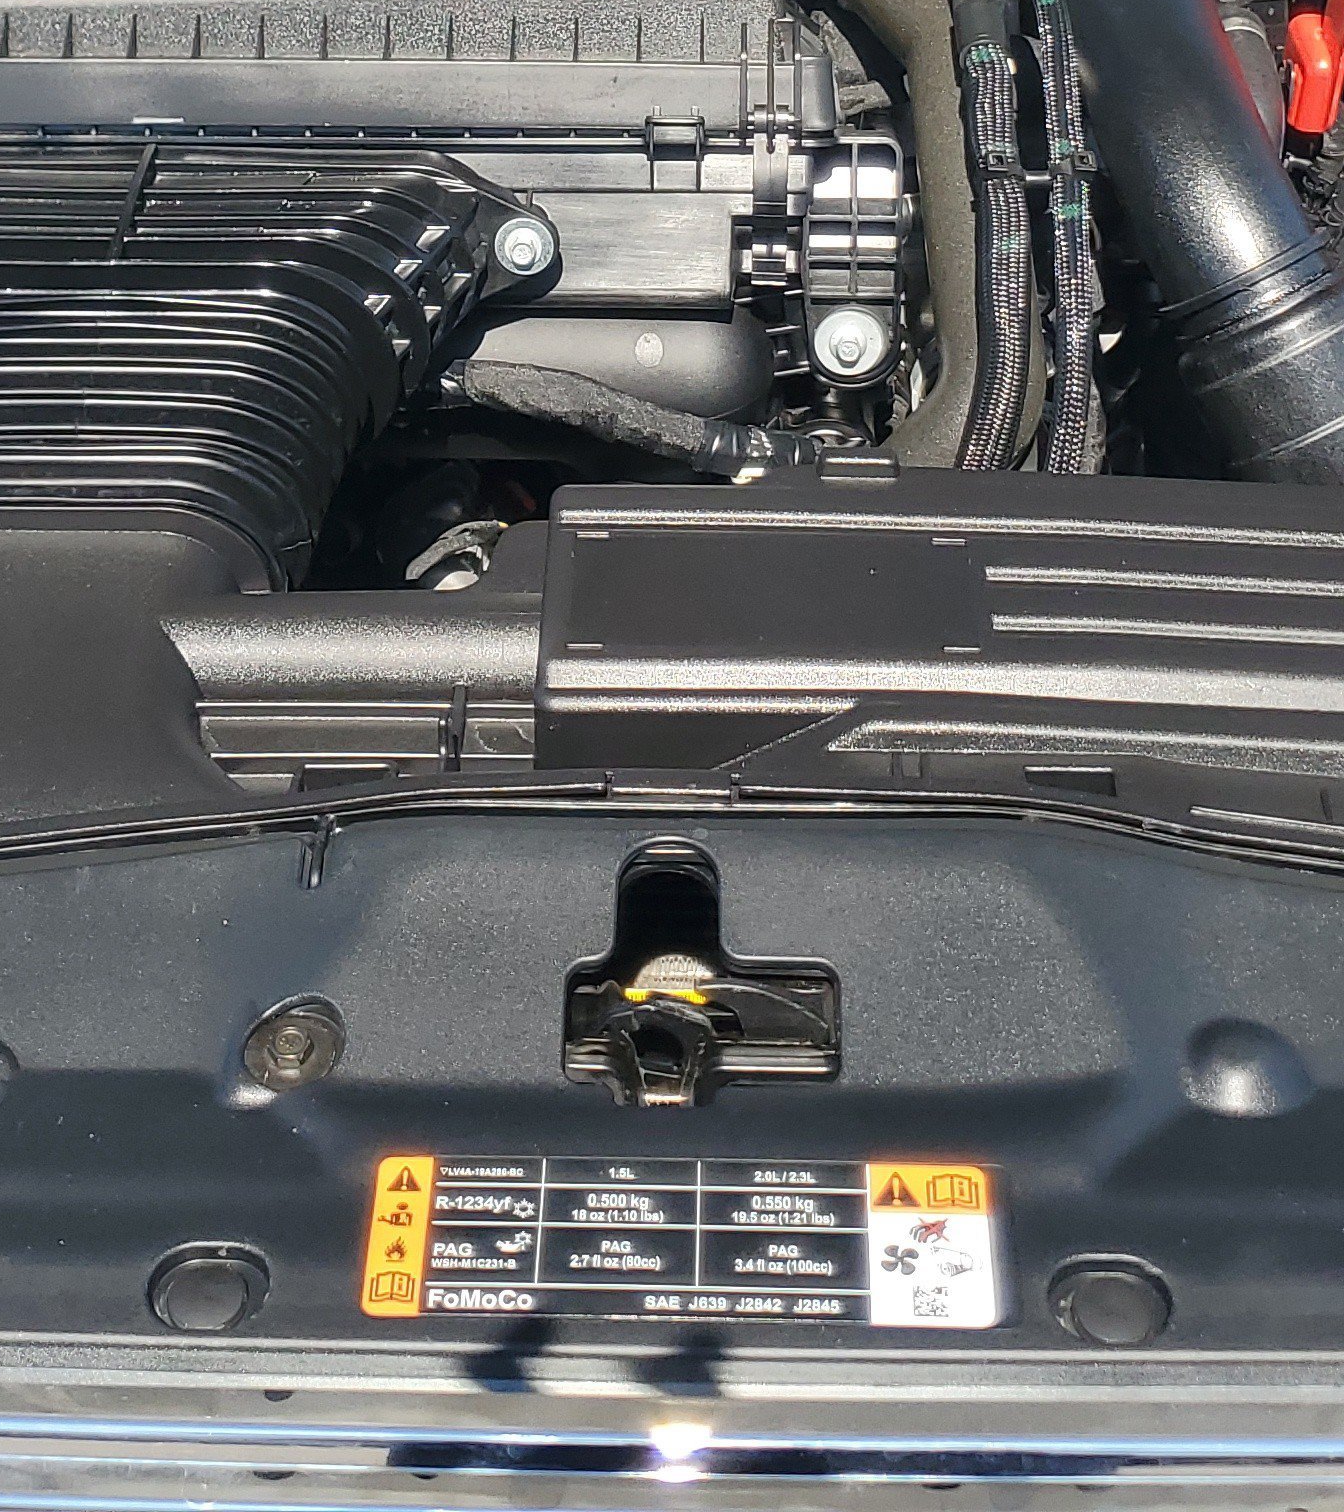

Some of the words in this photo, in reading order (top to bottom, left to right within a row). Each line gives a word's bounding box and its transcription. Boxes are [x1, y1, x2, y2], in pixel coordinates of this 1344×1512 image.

[608, 1167, 635, 1179] 1.5L
[754, 1170, 782, 1183] 2.0L
[788, 1171, 816, 1183] 2.3L
[435, 1195, 512, 1214] R-1234yf
[587, 1193, 627, 1207] 0.500
[630, 1193, 650, 1211] kg
[752, 1195, 791, 1210] 0.550
[795, 1196, 814, 1212] kg
[571, 1208, 587, 1221] 18
[589, 1211, 605, 1221] oz
[607, 1209, 638, 1223] (1.10
[640, 1210, 664, 1223] lbs)
[731, 1211, 758, 1223] 19.5
[760, 1213, 776, 1223] oz
[778, 1212, 808, 1225] (1.21
[811, 1212, 835, 1226] lbs)
[432, 1242, 474, 1257] PAG
[601, 1240, 632, 1253] PAG
[768, 1244, 799, 1257] PAG
[431, 1258, 517, 1269] WSH-M1C231-B
[569, 1254, 590, 1268] 2.7
[592, 1254, 601, 1268] fl
[603, 1257, 620, 1268] oz
[622, 1255, 661, 1271] (80cc)
[734, 1258, 754, 1272] 3.4
[756, 1258, 765, 1272] fl
[768, 1261, 784, 1271] oz
[786, 1259, 833, 1276] (100cc)
[426, 1288, 534, 1309] FoMoCo
[644, 1295, 681, 1310] SAE
[687, 1296, 727, 1310] J639
[735, 1297, 782, 1311] J2842
[793, 1298, 840, 1313] J2845
